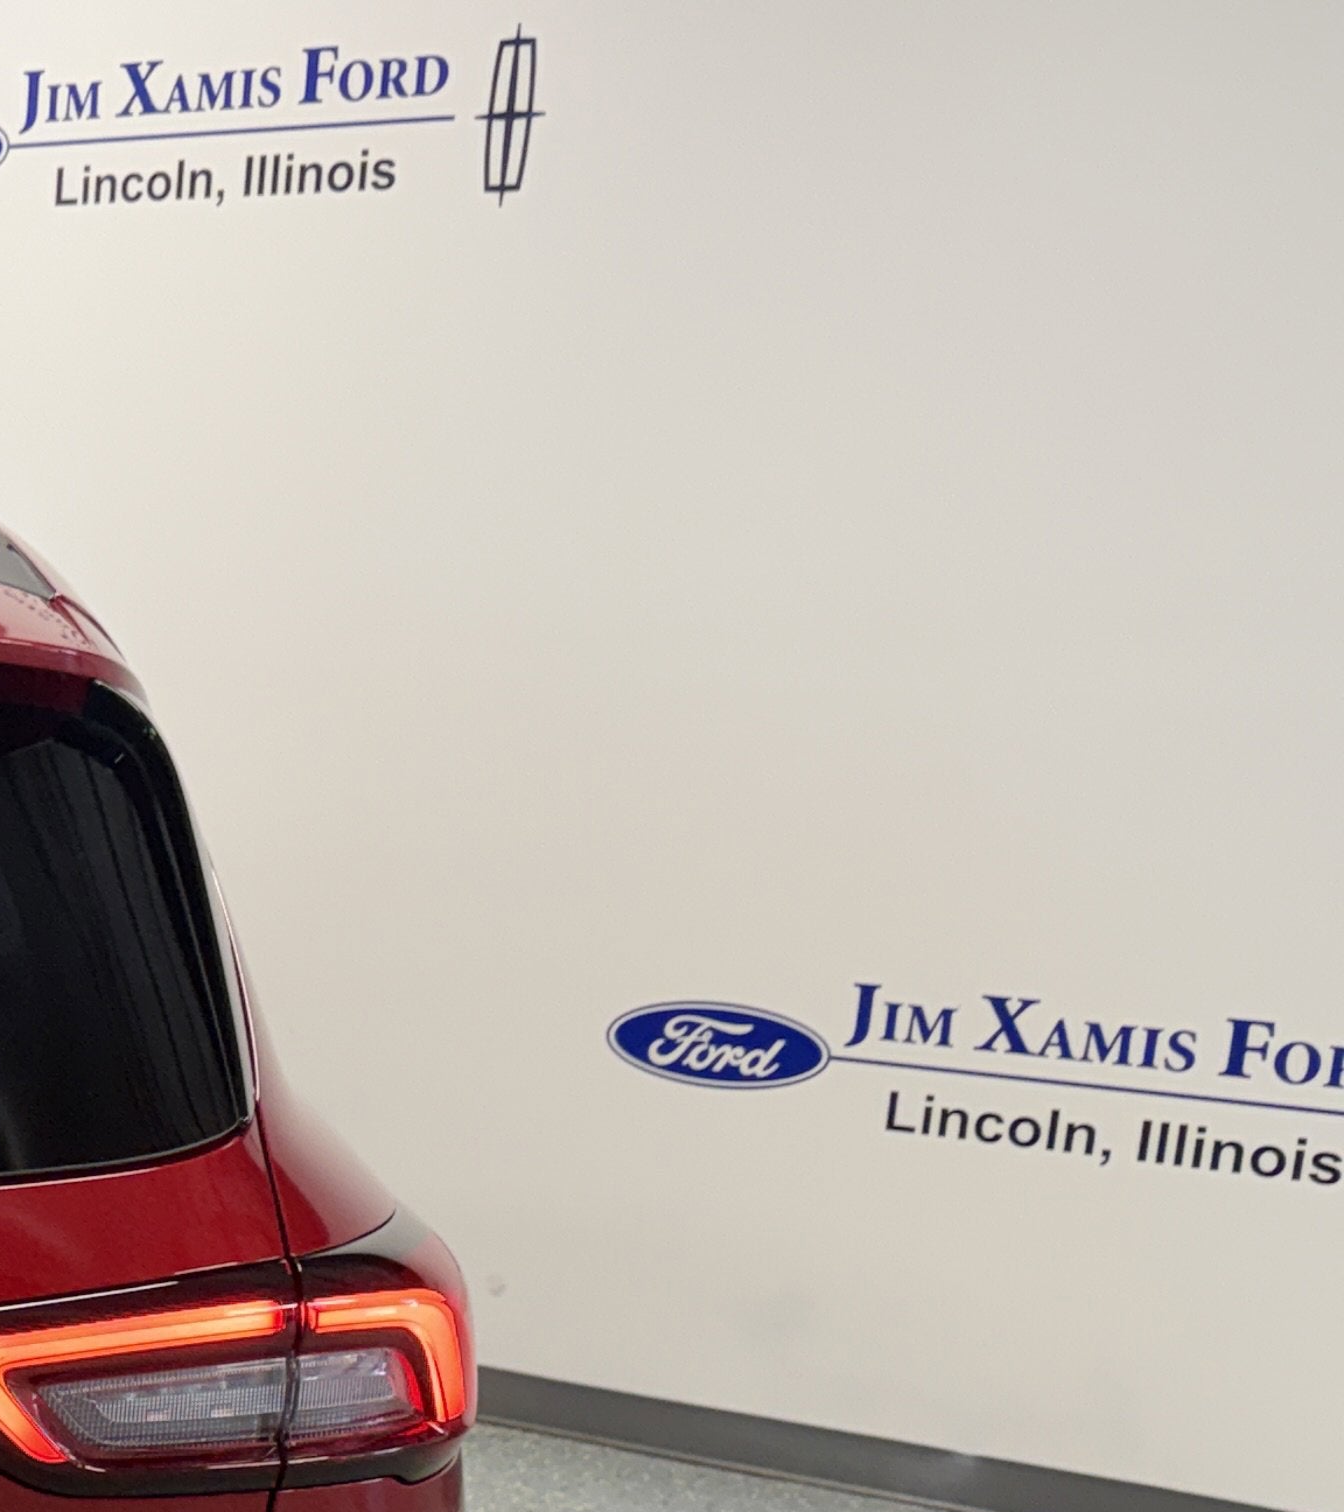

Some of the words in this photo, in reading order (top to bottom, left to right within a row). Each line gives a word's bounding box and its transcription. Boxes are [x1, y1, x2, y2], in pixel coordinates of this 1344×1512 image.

[18, 70, 102, 135] JIM
[115, 60, 283, 118] XAMIS
[299, 45, 450, 105] FORD
[53, 159, 226, 207] Lincoln,
[242, 149, 397, 197] Illinois
[647, 1015, 780, 1080] Ford
[845, 982, 957, 1050] JIM
[974, 994, 1197, 1073] XAMIS
[1218, 1017, 1344, 1089] FO
[883, 1090, 1112, 1166] Lincoln,
[1135, 1119, 1343, 1186] Illinois
